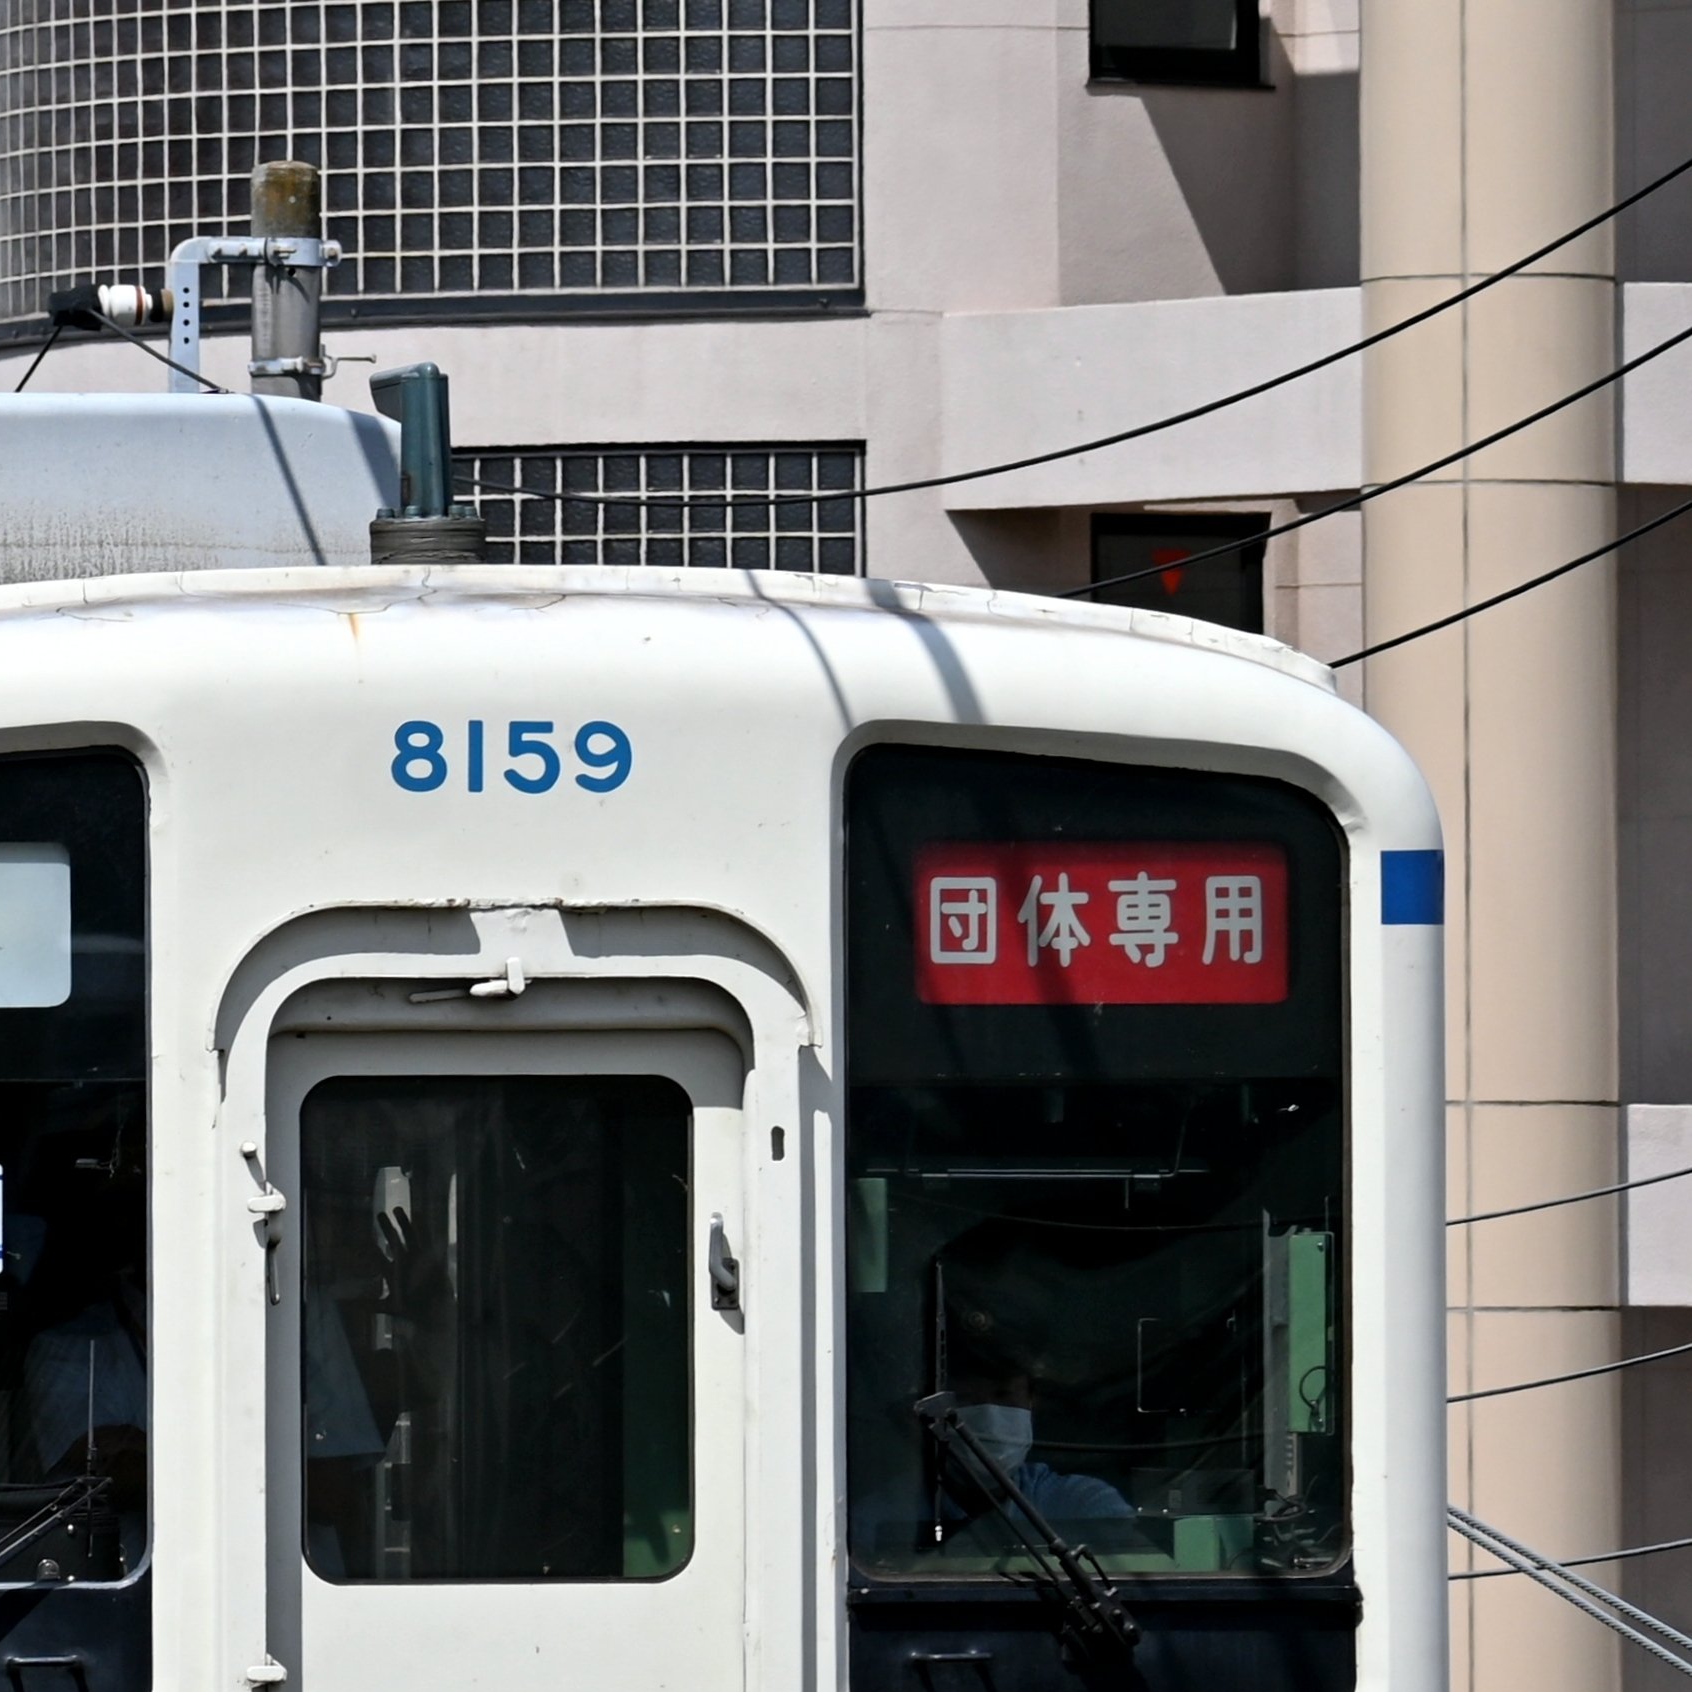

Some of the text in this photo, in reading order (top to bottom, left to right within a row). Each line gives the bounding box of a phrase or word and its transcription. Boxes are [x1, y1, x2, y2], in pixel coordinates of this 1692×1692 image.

[391, 719, 632, 794] 8159
[929, 870, 1263, 968] 団体専用
